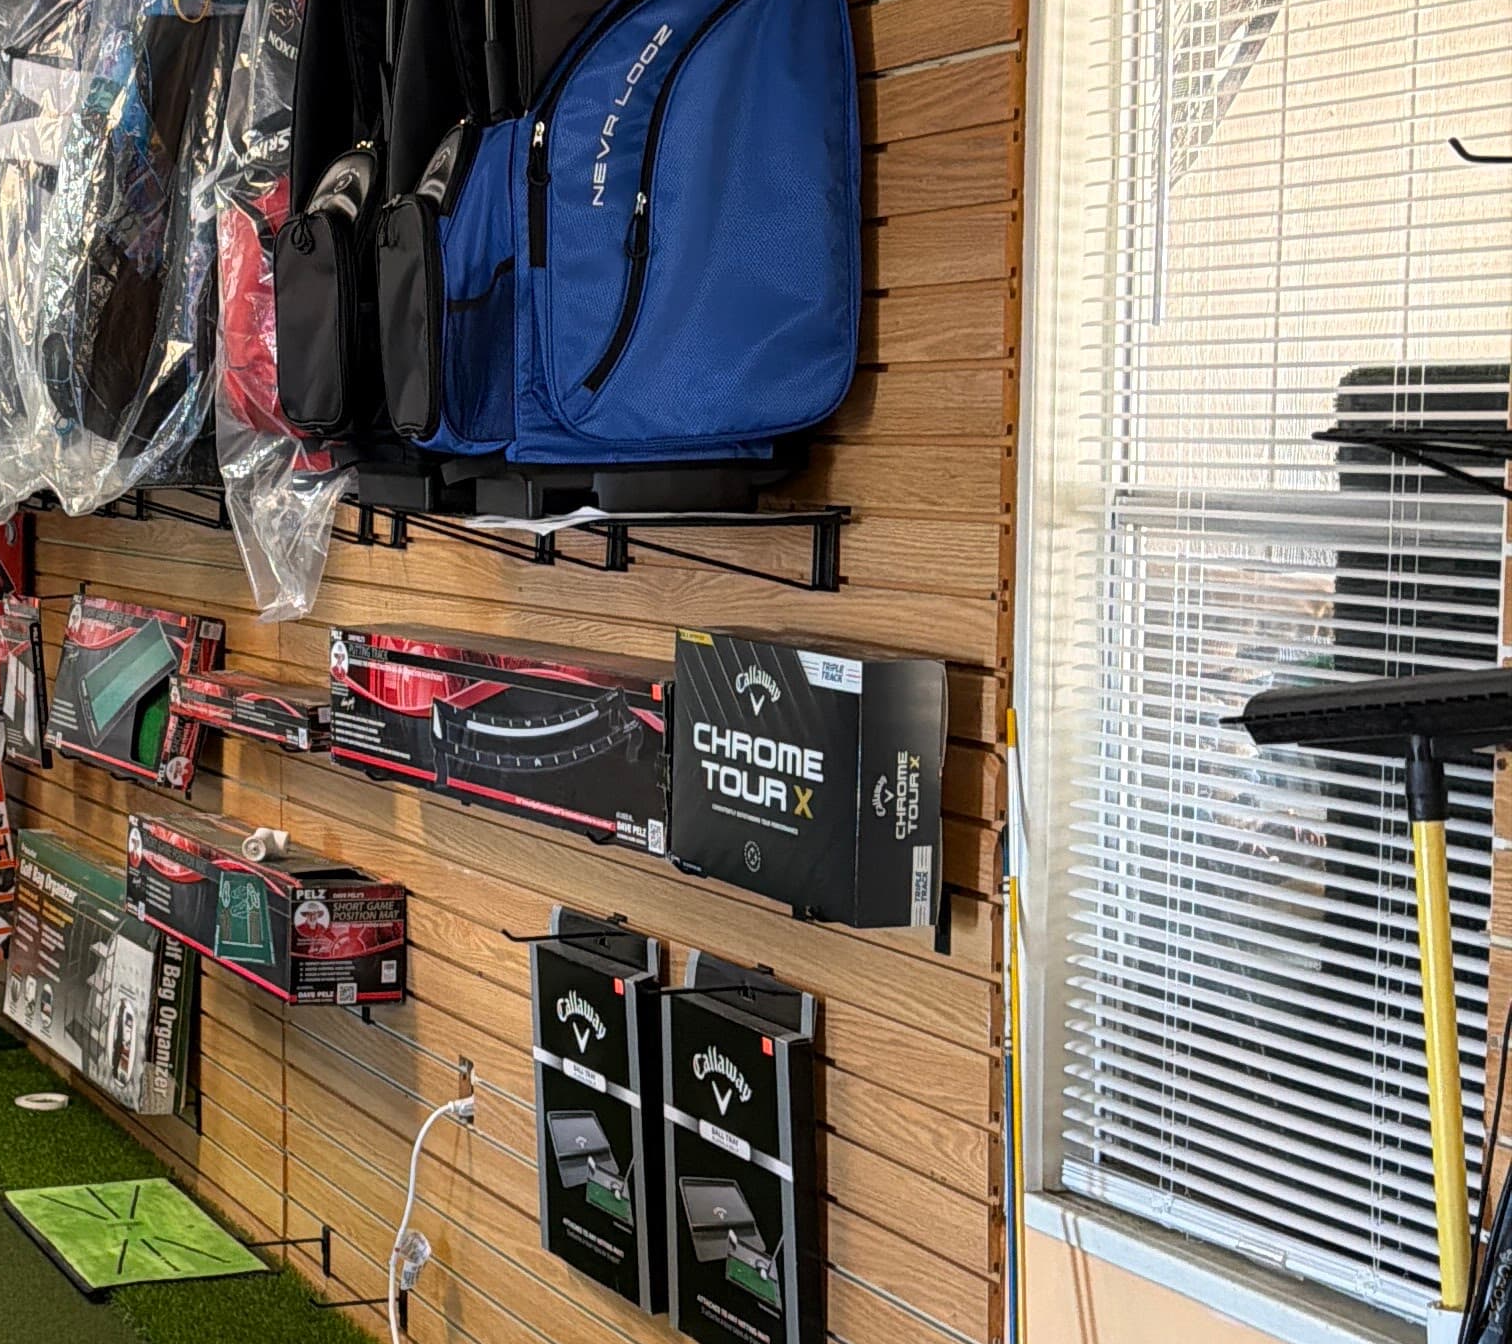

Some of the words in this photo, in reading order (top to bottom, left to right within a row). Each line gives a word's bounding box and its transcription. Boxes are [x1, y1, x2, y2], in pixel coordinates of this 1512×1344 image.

[269, 30, 299, 61] IXON
[592, 114, 619, 206] NEVR
[615, 24, 673, 106] LOOZ
[735, 664, 782, 703] Callaway
[821, 661, 845, 675] TRIPLE
[821, 670, 844, 684] TRACK
[692, 721, 825, 783] CHROME
[909, 755, 921, 769] X
[701, 759, 788, 812] TOUR
[793, 784, 814, 819] X
[872, 774, 888, 818] Callaway
[895, 750, 908, 841] CHROME
[907, 772, 920, 835] TOUR
[295, 888, 327, 900] PELZ
[332, 901, 364, 912] SHORT
[366, 901, 395, 911] GAME
[332, 910, 377, 921] POSITION
[379, 909, 400, 919] MAT
[165, 935, 186, 967] olf
[157, 967, 182, 1001] Bag
[557, 989, 607, 1040] Callaway
[153, 1006, 178, 1100] Organizer
[692, 1044, 753, 1103] Callaway
